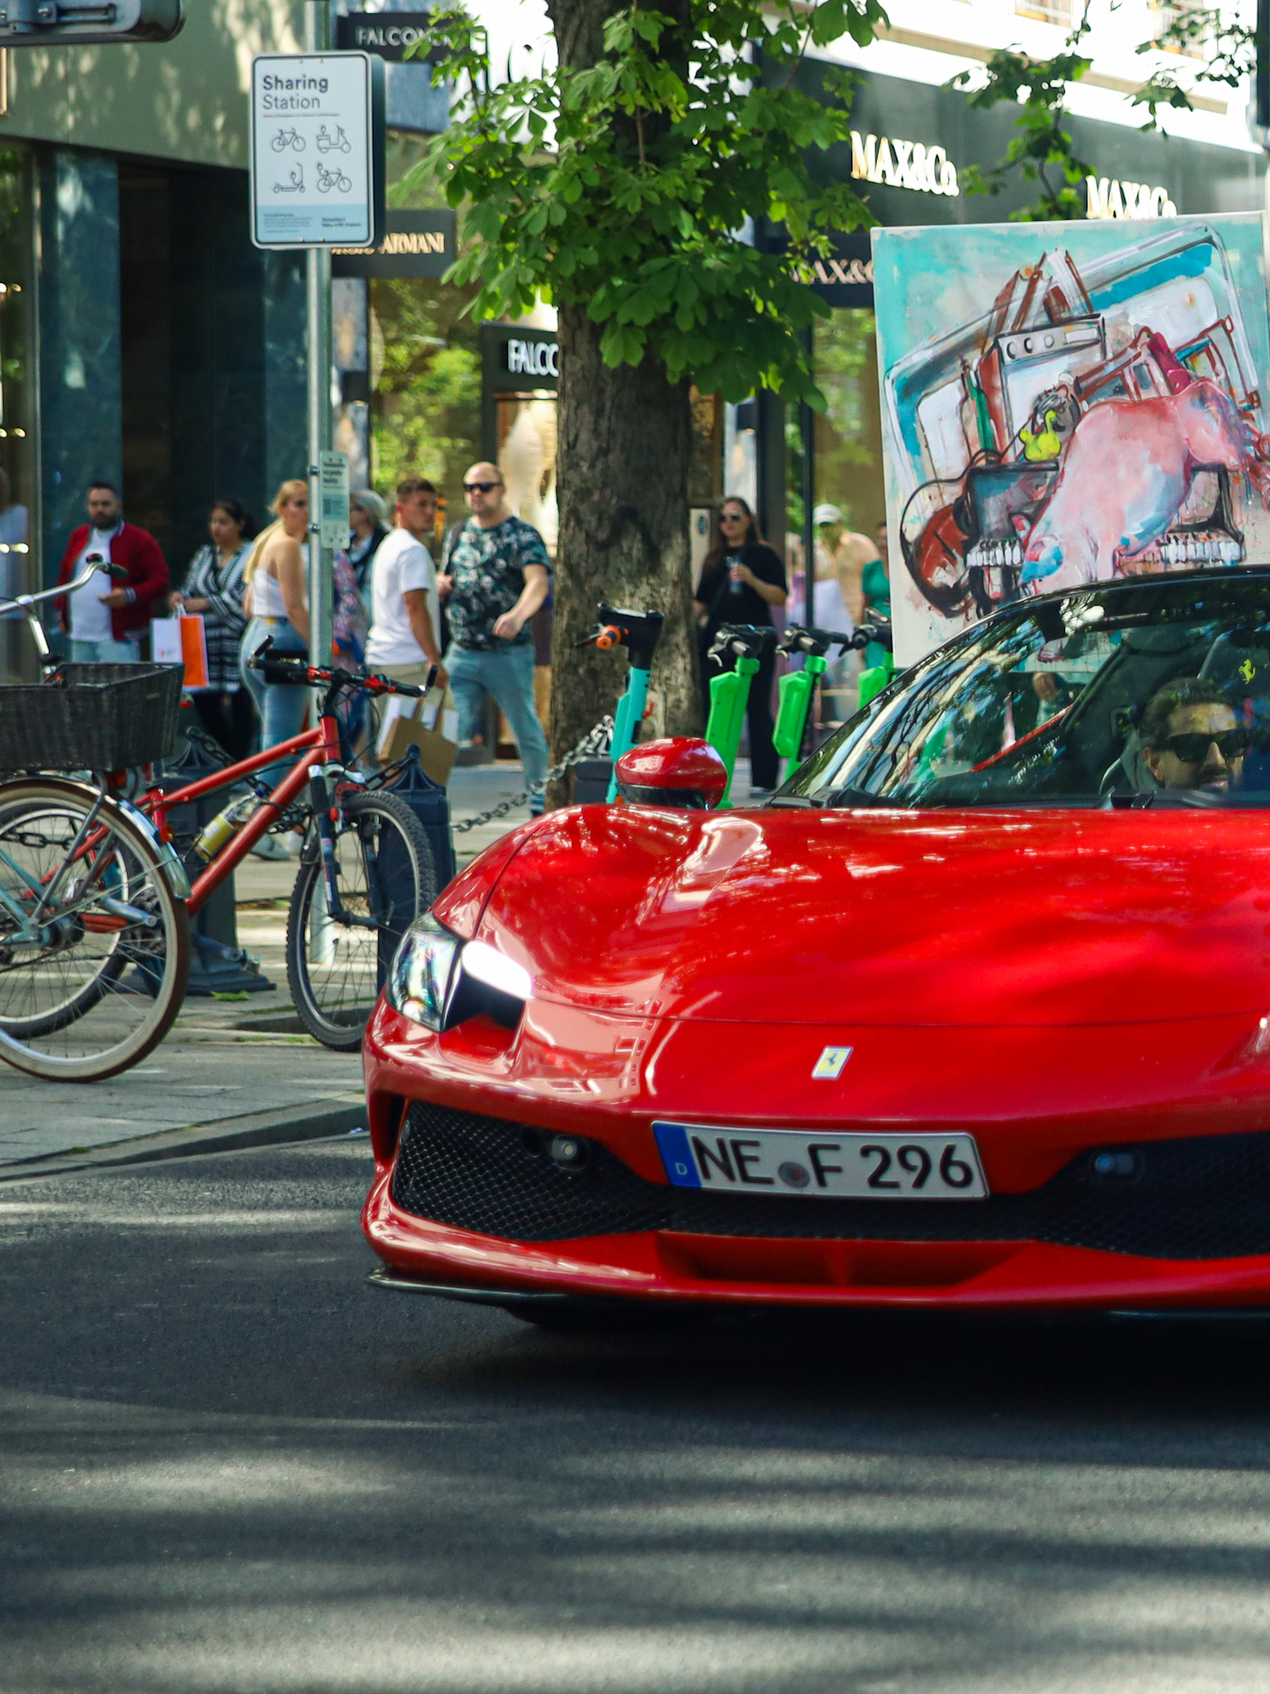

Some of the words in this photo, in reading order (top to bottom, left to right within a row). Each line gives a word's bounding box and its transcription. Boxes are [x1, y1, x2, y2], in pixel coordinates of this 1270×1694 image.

[263, 74, 328, 93] Sharing
[263, 94, 320, 110] Station
[380, 232, 445, 254] ARMANI
[675, 1162, 687, 1176] D
[691, 1135, 775, 1185] NE
[807, 1143, 842, 1187] F
[859, 1143, 973, 1188] 296
